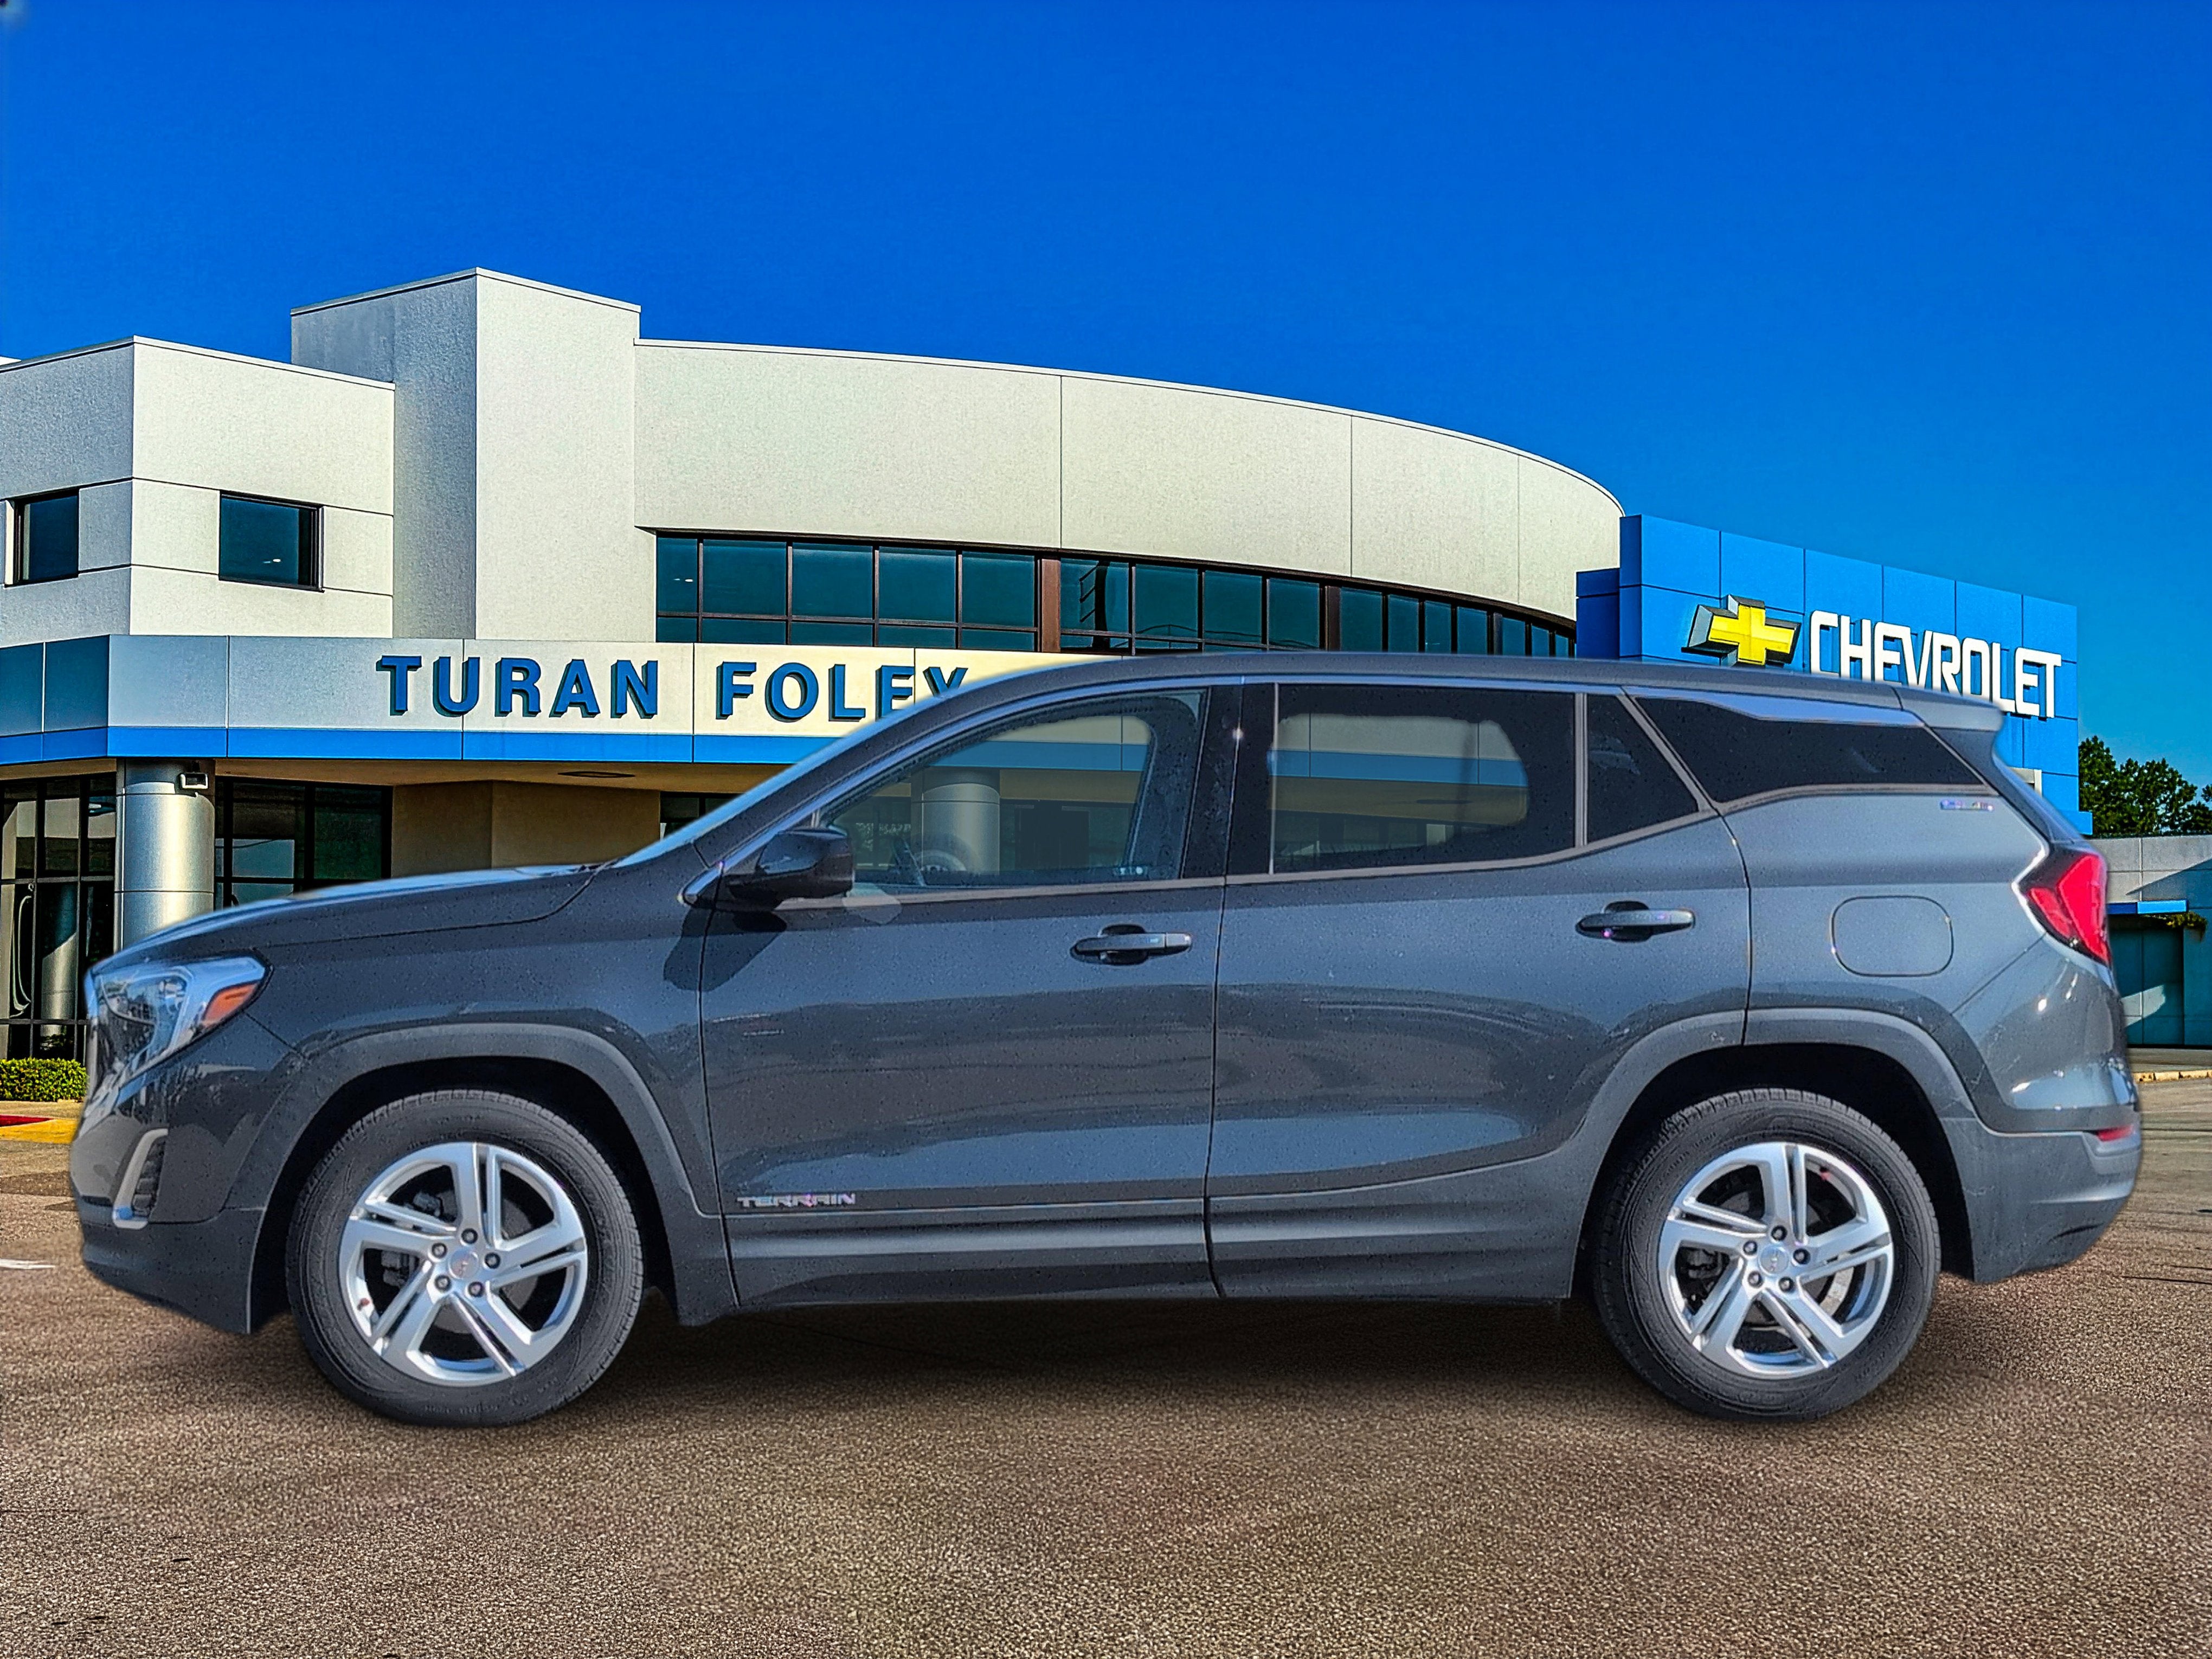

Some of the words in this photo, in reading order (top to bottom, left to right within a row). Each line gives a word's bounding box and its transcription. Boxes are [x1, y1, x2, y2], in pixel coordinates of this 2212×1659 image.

[376, 655, 658, 719] TURAN
[1810, 610, 2062, 718] CHEVROLET
[737, 1192, 856, 1208] TERRAIN
